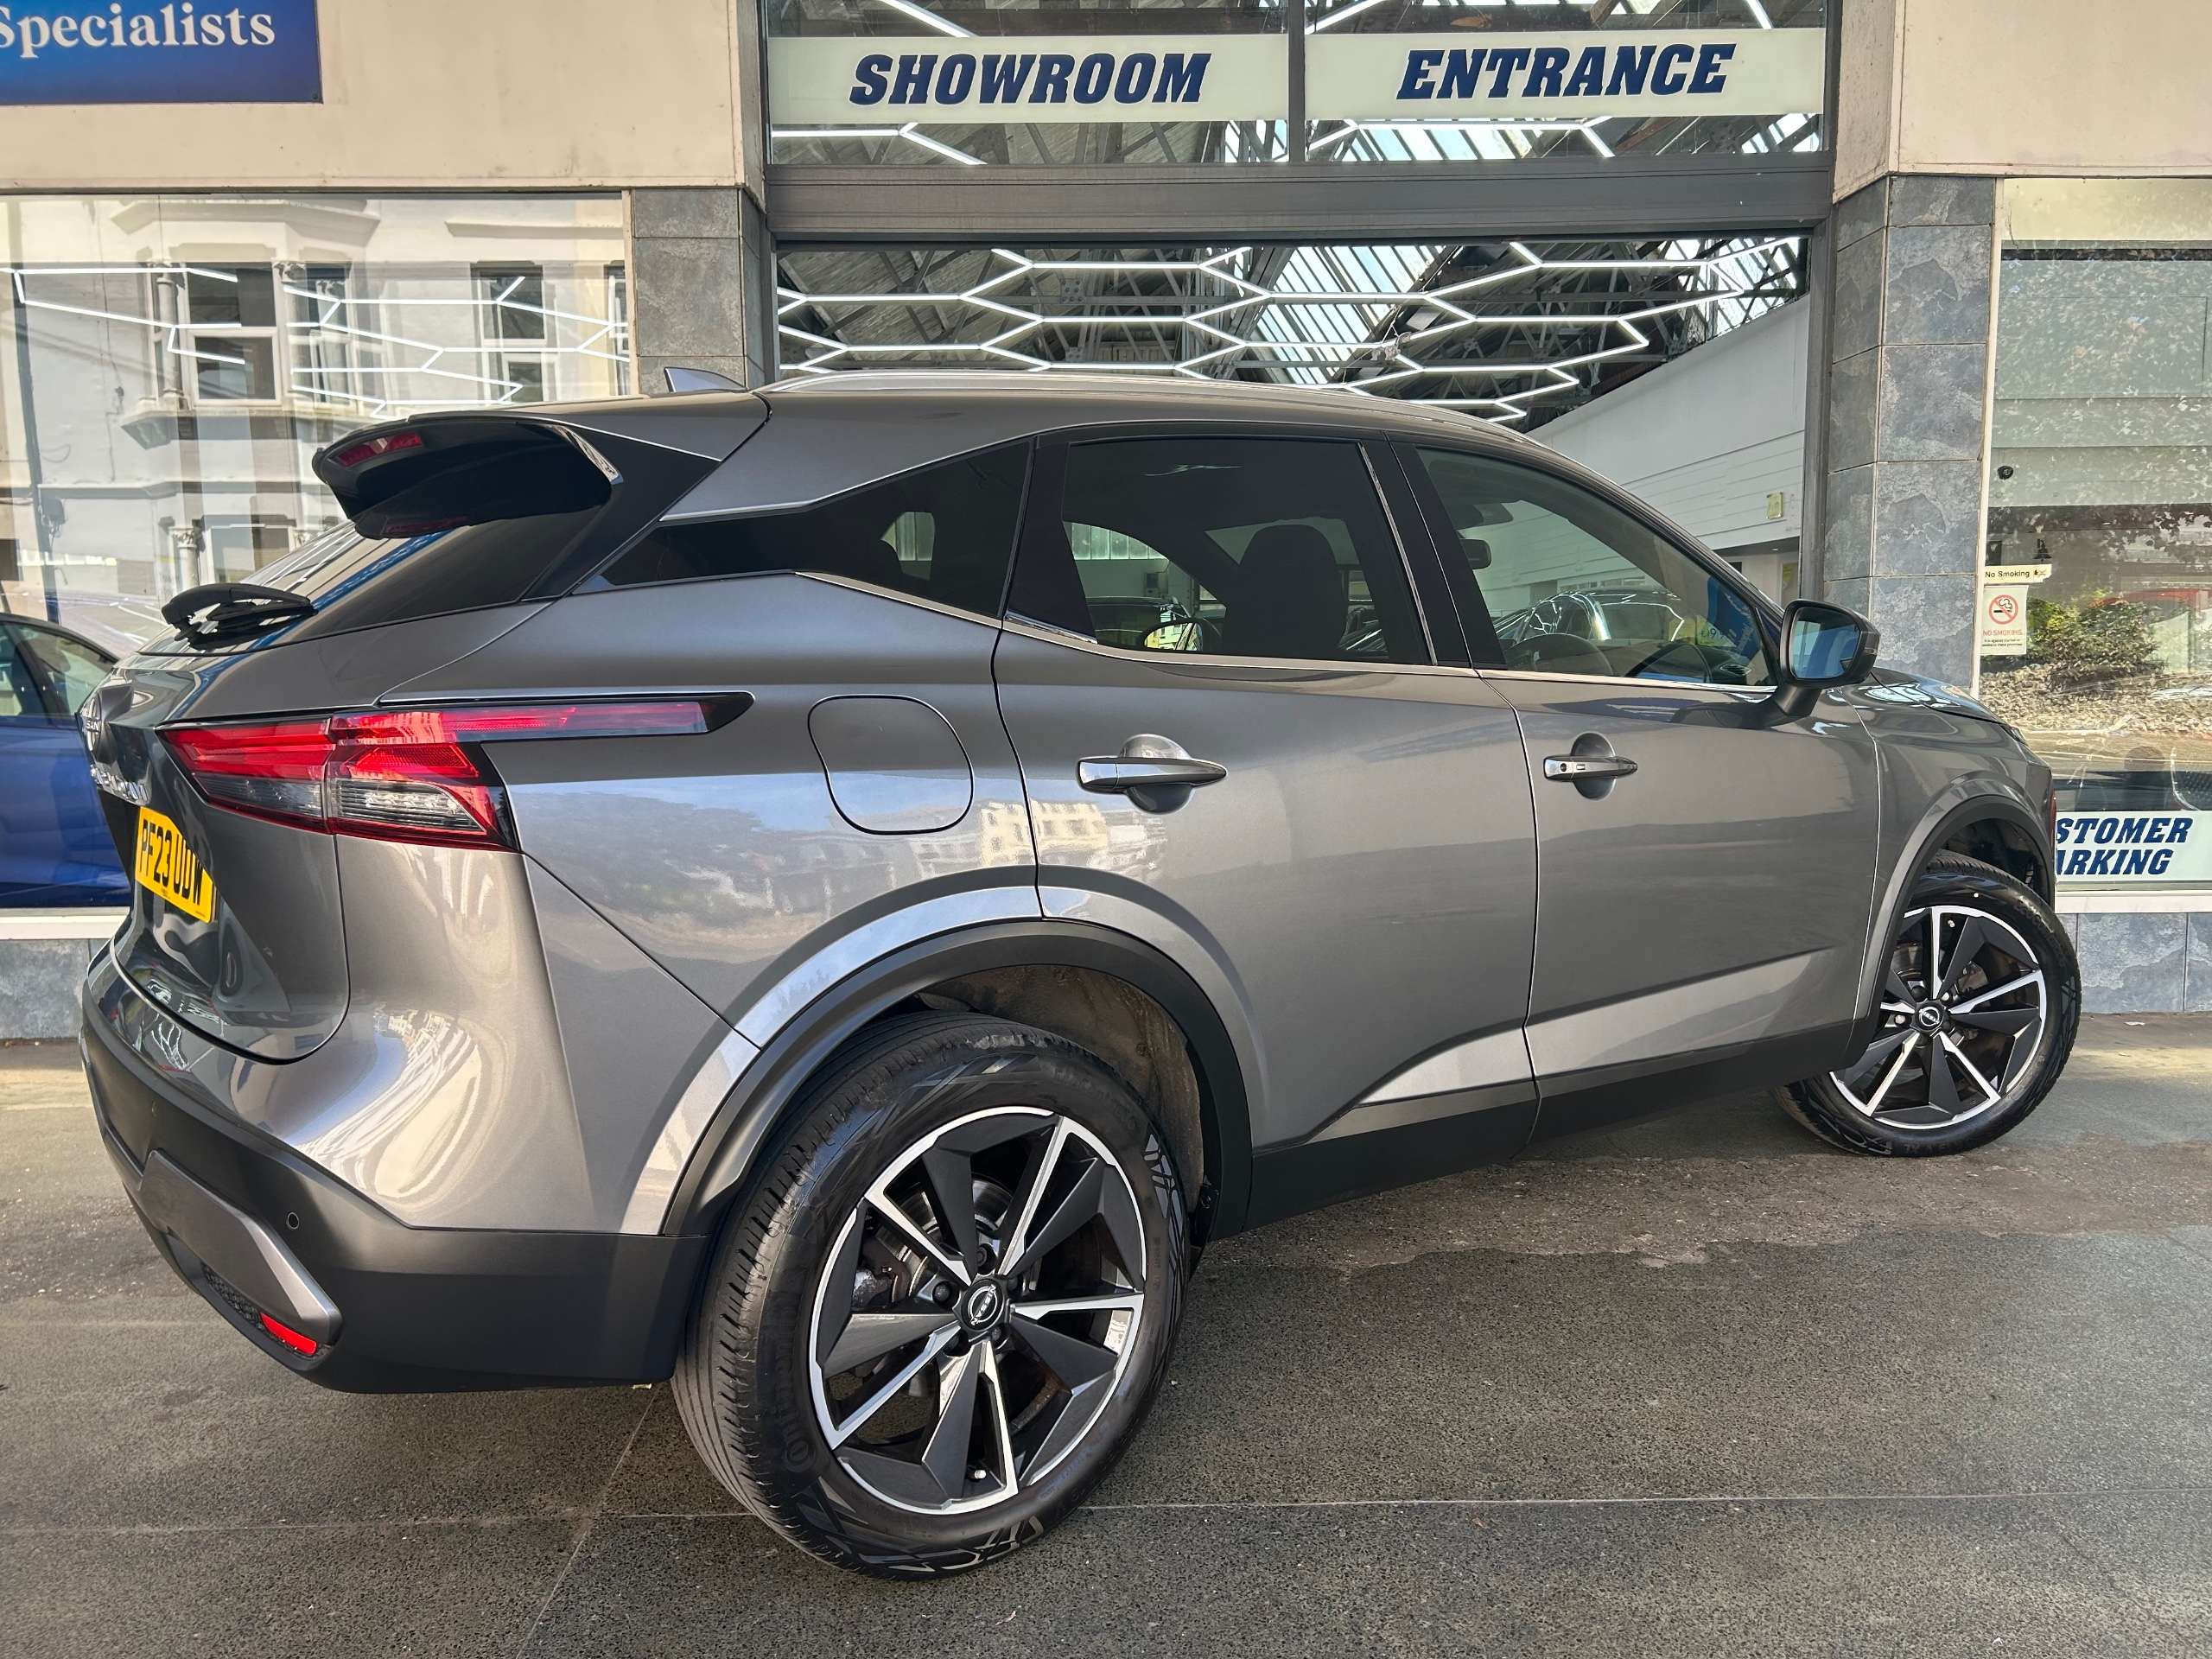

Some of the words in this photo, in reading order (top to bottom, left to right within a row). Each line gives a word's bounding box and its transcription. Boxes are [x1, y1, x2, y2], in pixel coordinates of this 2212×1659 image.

[849, 53, 1212, 105] SHOWROOM
[1395, 42, 1738, 100] ENTRANCE
[1998, 569, 2031, 579] Smoking
[2056, 817, 2194, 844] STOMER
[139, 817, 173, 887] PF23
[2056, 849, 2174, 875] RKING
